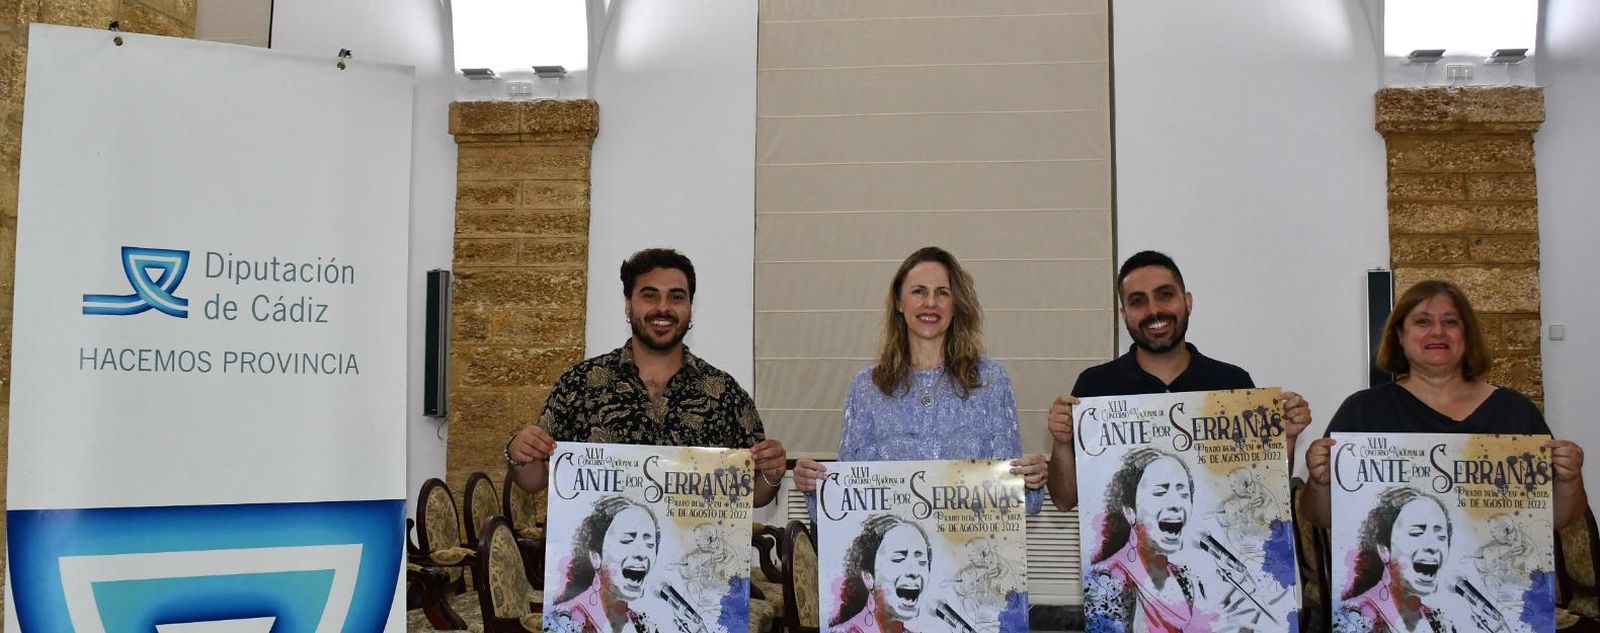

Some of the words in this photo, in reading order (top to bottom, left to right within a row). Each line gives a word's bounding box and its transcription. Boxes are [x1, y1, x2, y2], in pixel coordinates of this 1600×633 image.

[205, 251, 355, 285] Diputación
[204, 293, 238, 321] de
[251, 294, 329, 324] Cádiz
[79, 347, 212, 373] HACEMOS
[223, 351, 360, 375] PROVINCIA
[1108, 400, 1127, 412] XLVI
[1078, 408, 1151, 456] CANTE
[1152, 424, 1171, 438] POR
[1169, 403, 1283, 452] SERRANAS
[1367, 437, 1387, 449] XLVI
[586, 448, 604, 459] XLVI
[1197, 455, 1206, 464] 26
[1209, 455, 1220, 464] DE
[1222, 453, 1250, 463] AGOSTO
[1251, 452, 1261, 461] DE
[1264, 451, 1281, 460] 2022
[851, 466, 869, 478] XLVI
[1335, 443, 1411, 492] CANTE
[1412, 465, 1431, 478] POR
[1429, 443, 1550, 493] SERRANAS
[554, 452, 624, 500] CANTE
[625, 476, 644, 488] POR
[643, 455, 752, 503] SERRANAS
[820, 472, 892, 521] CANTE
[893, 493, 911, 505] POR
[910, 471, 1022, 519] SERRANAS
[1457, 499, 1466, 508] 26
[1470, 499, 1480, 508] DE
[1483, 499, 1512, 508] AGOSTO
[1514, 500, 1524, 508] DE
[1527, 500, 1546, 509] 2022
[666, 509, 674, 517] 26
[678, 509, 686, 517] DE
[690, 509, 717, 518] AGOSTO
[718, 510, 726, 519] DE
[730, 510, 747, 519] 2022
[936, 524, 945, 532] 26
[948, 523, 958, 532] DE
[960, 523, 989, 532] AGOSTO
[990, 522, 1000, 532] DE
[1001, 522, 1020, 532] 2022
